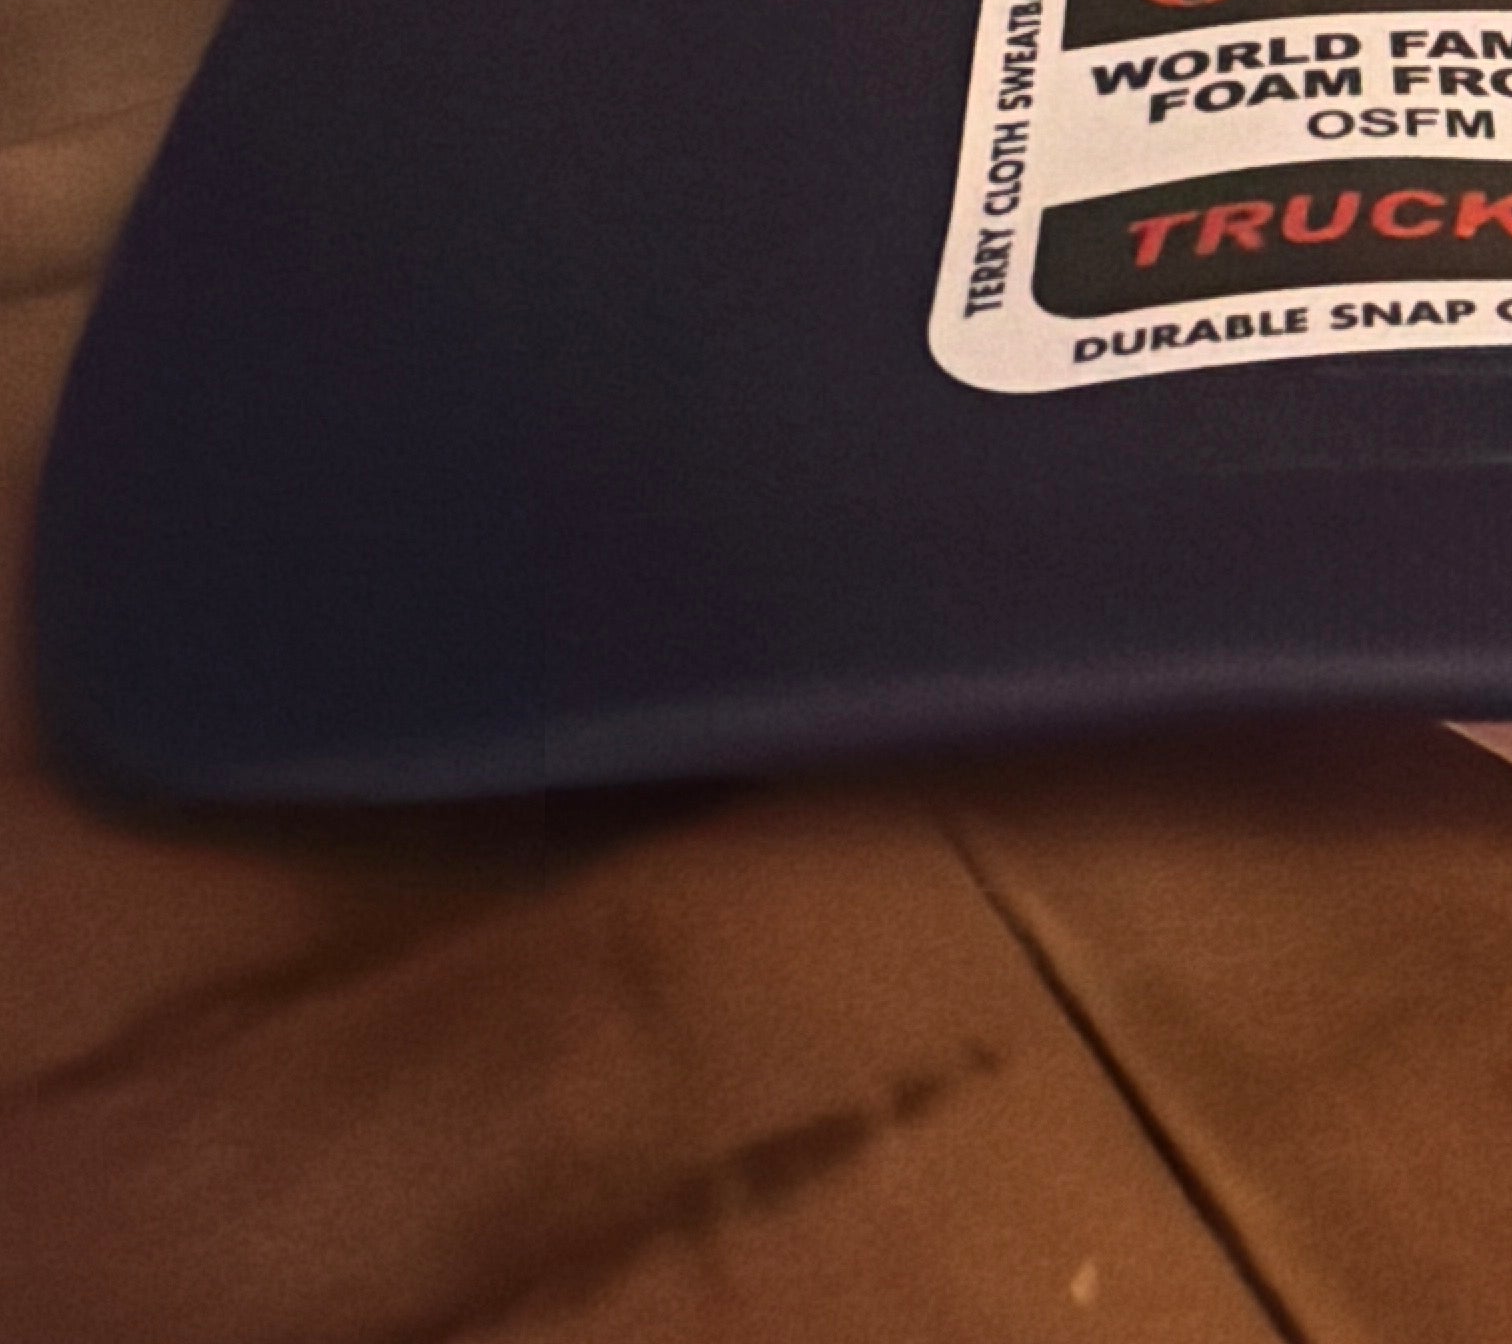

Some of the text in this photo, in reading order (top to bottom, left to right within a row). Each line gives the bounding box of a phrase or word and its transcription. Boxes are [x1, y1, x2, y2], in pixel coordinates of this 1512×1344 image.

[1090, 32, 1363, 97] WORLD
[1147, 67, 1364, 124] FOAM
[1306, 108, 1497, 140] OSFM
[983, 120, 1029, 217] CLOTH
[962, 227, 1014, 319] TERRY
[1072, 307, 1310, 364] DURABLE
[1329, 297, 1477, 332] SNAP
